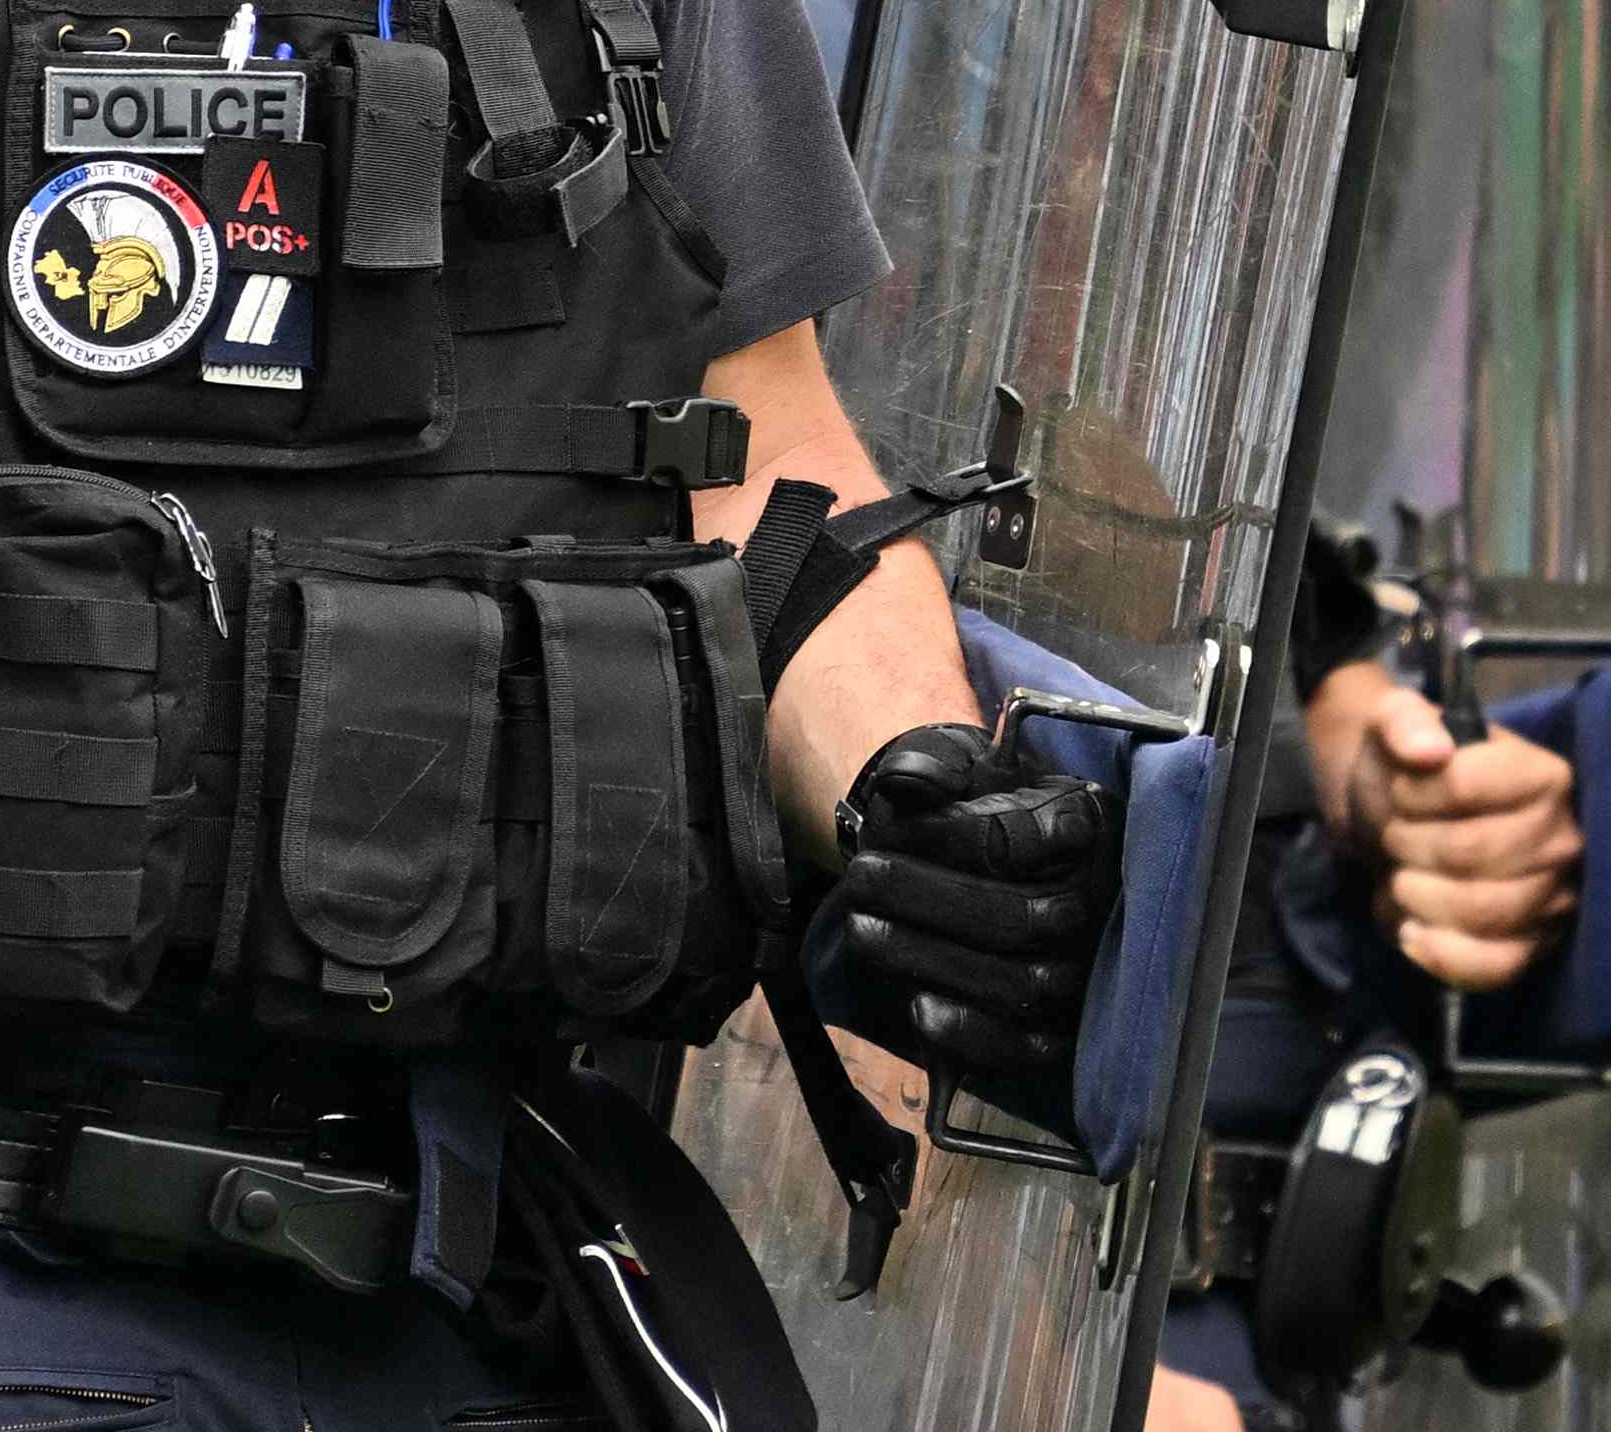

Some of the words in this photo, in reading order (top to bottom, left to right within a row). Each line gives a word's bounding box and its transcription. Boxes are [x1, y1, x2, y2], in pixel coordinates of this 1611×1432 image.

[63, 86, 287, 140] POLICE
[237, 159, 279, 215] A
[226, 221, 309, 254] POS+
[11, 210, 38, 302] COMPAGNIE
[26, 306, 157, 367] DEPARTEMENTALE
[165, 225, 214, 349] D'INTERVENTION
